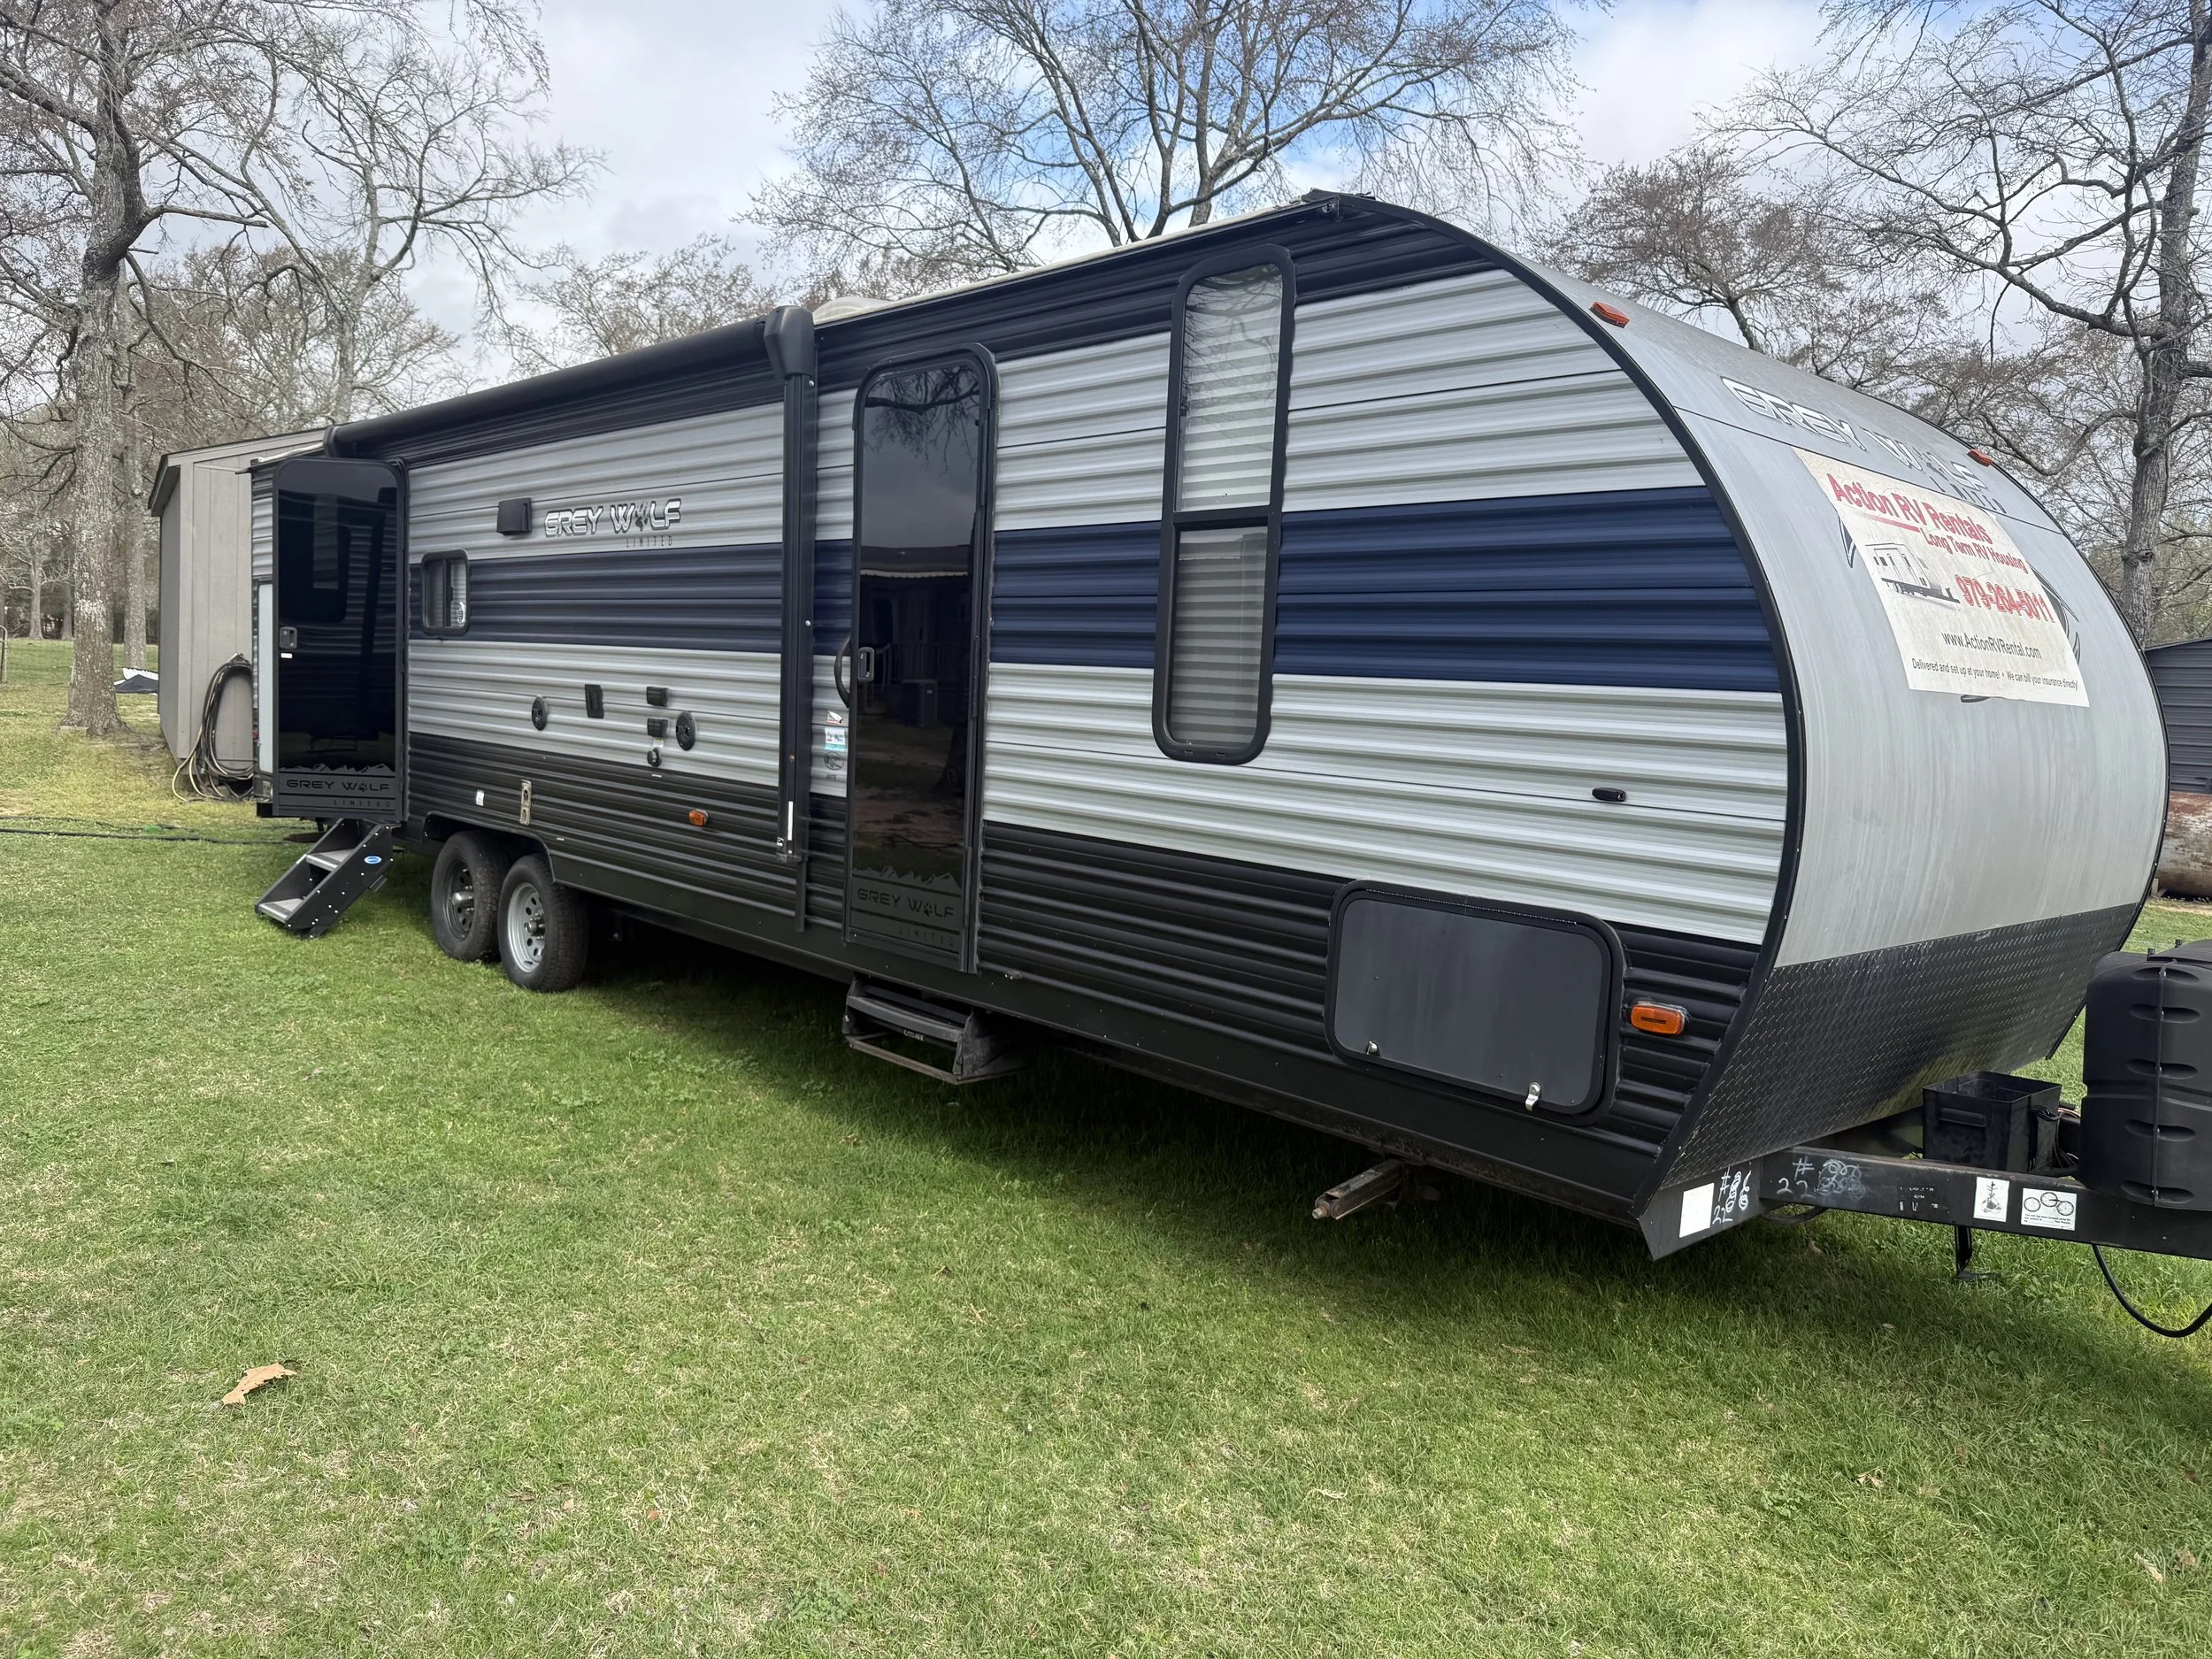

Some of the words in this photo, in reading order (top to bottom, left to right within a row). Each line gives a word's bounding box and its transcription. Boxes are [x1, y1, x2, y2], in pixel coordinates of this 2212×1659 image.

[1720, 376, 1868, 452] GREY
[544, 505, 604, 538] GREY
[1826, 473, 1900, 518] Action
[1891, 492, 1927, 526] RV
[1921, 501, 1993, 545] Rentals
[626, 534, 674, 549] LIMITED
[1920, 527, 1954, 555] Long
[1947, 534, 1978, 557] Term
[1973, 545, 1992, 563] RV
[1990, 547, 2030, 574] Housing
[1955, 573, 2055, 624] 979-264-5011
[1941, 632, 2042, 660] www.ActionRVRental.com
[1911, 657, 1939, 672] Delivered
[1939, 663, 1950, 673] and
[1950, 664, 1959, 674] set
[1959, 667, 1967, 678] up
[1967, 666, 1973, 676] at
[1972, 669, 1985, 680] your
[1985, 668, 2000, 679] home!
[2006, 671, 2014, 680] We
[2014, 672, 2024, 682] can
[2023, 673, 2032, 683] bill
[2031, 675, 2042, 686] your
[2041, 675, 2062, 687] insurance
[2062, 679, 2078, 691] directly!
[286, 780, 335, 790] GREY
[334, 800, 391, 809] LIMITED
[856, 887, 901, 907] GREY
